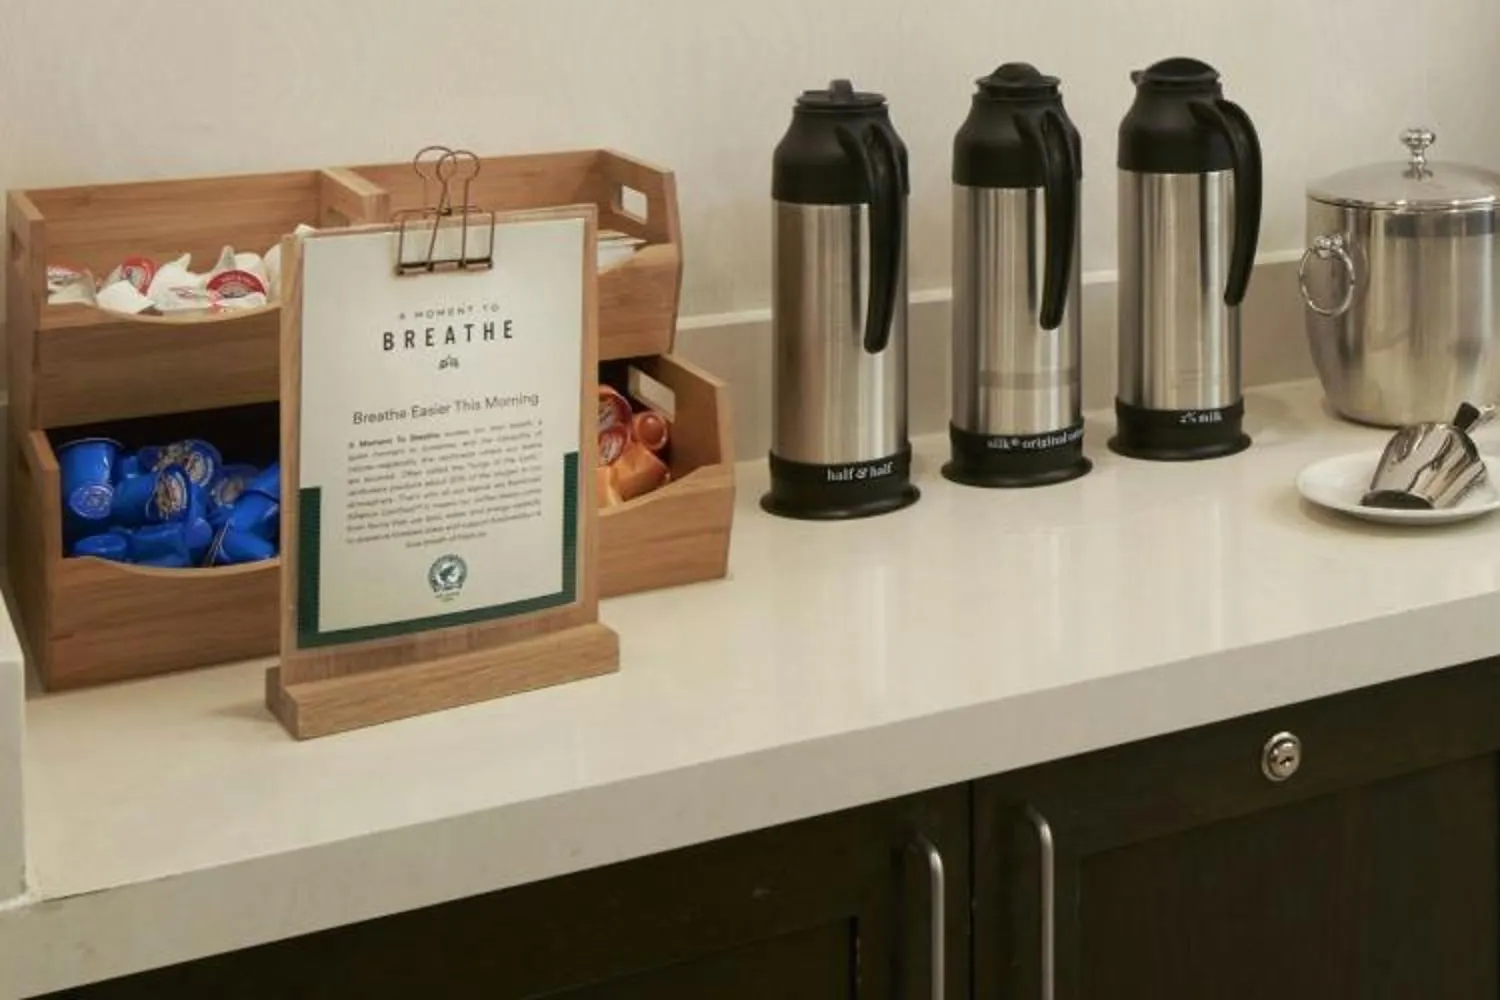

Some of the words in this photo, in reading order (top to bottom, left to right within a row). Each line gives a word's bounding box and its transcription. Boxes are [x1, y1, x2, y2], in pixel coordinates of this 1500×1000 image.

[382, 319, 513, 351] BREATHE
[352, 409, 407, 425] Breathe
[411, 405, 450, 418] Easier
[455, 399, 482, 412] This
[485, 392, 540, 408] Morning
[1022, 431, 1068, 449] original
[826, 466, 854, 481] half
[856, 466, 868, 479] &
[869, 460, 895, 479] half
